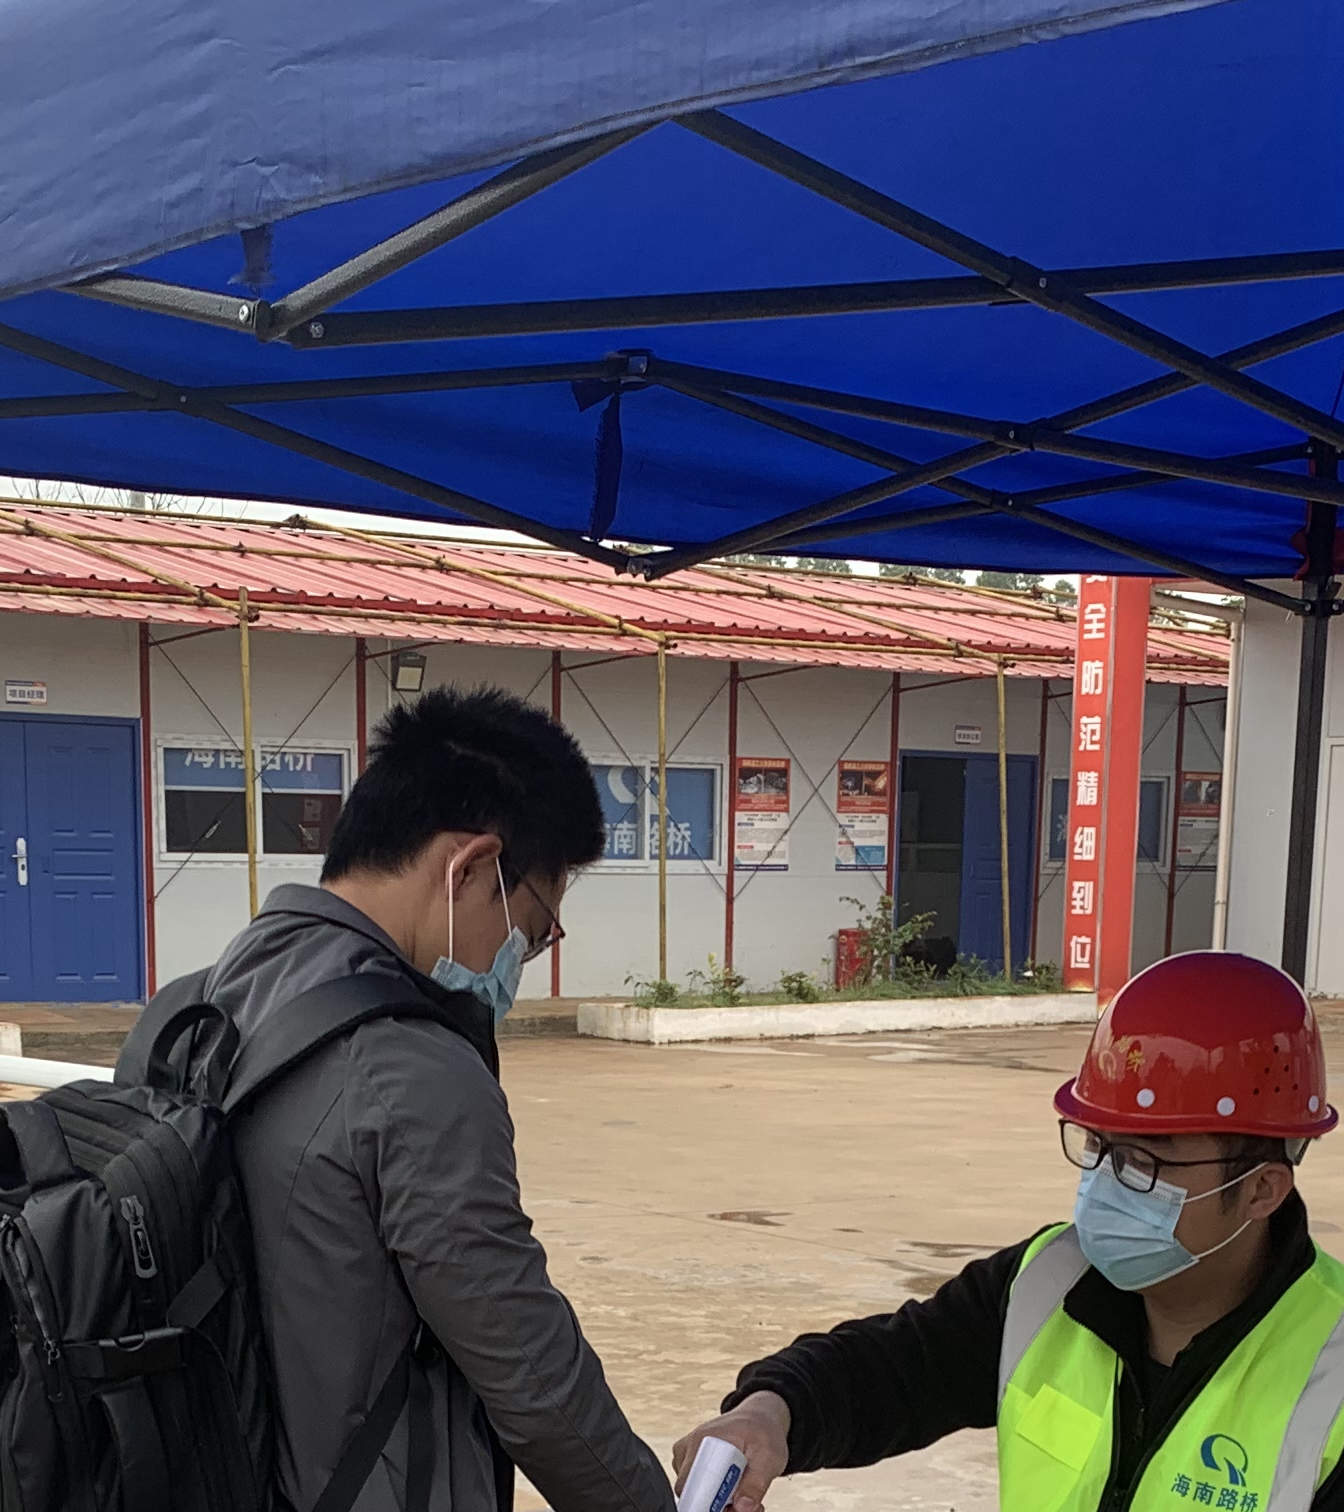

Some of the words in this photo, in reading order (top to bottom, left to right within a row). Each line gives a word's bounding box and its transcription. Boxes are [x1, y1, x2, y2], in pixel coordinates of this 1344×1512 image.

[604, 821, 692, 855] 南桥
[1070, 574, 1108, 968] 全防范精细到位
